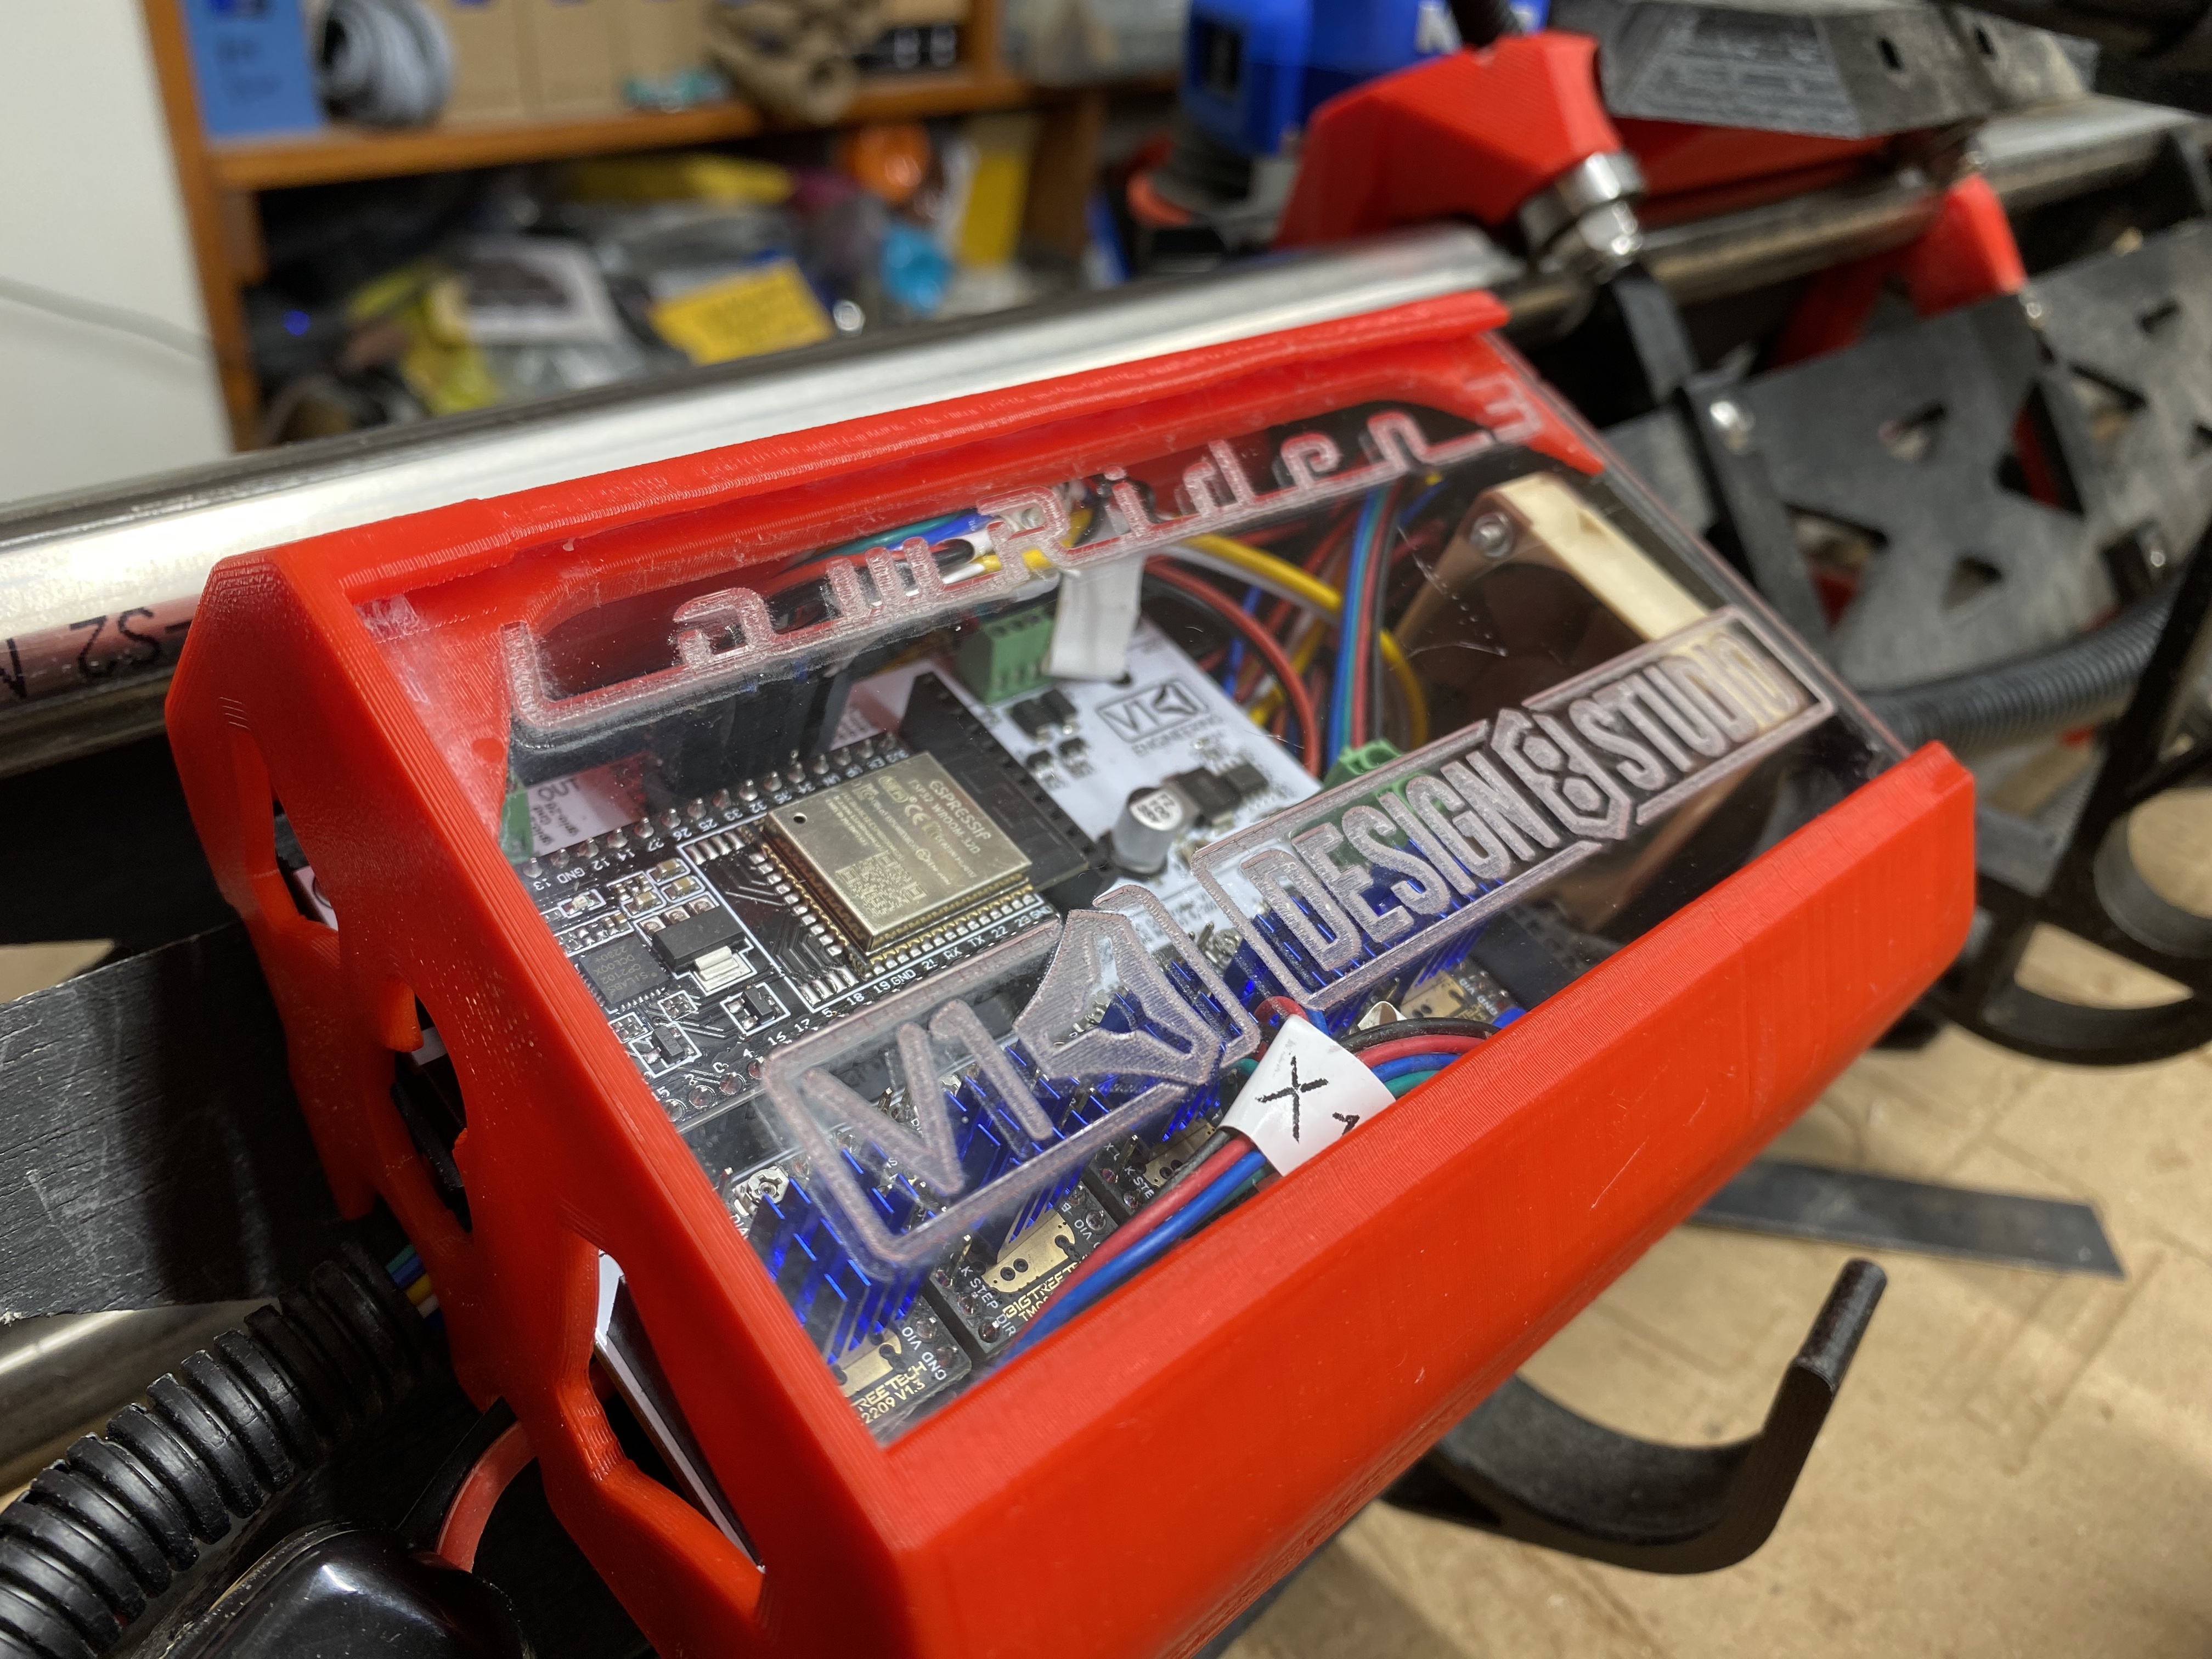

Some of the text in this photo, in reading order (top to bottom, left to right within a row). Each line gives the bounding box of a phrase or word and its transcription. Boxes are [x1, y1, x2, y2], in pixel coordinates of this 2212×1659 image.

[749, 799, 768, 814] 32
[1240, 750, 1561, 973] DESIGN
[1568, 633, 1808, 790] STUDIO
[724, 808, 743, 821] 33
[673, 826, 692, 841] 26
[698, 817, 718, 832] 25
[591, 856, 610, 871] 12
[617, 848, 635, 862] 14
[533, 878, 551, 891] 13
[557, 867, 586, 884] GND
[847, 992, 865, 1006] 18
[873, 981, 890, 994] 19
[890, 969, 917, 986] GND
[922, 958, 938, 970] 21
[943, 946, 962, 960] RX
[967, 935, 986, 947] TX
[991, 926, 1008, 938] 22
[1014, 915, 1031, 928] 23
[601, 963, 641, 985] CP2102
[1133, 1176, 1155, 1200] STE
[1074, 1219, 1093, 1240] VIO
[970, 1277, 1017, 1337] STEP DIR
[901, 1326, 947, 1381] VIO GND
[894, 1378, 926, 1401] V1.3
